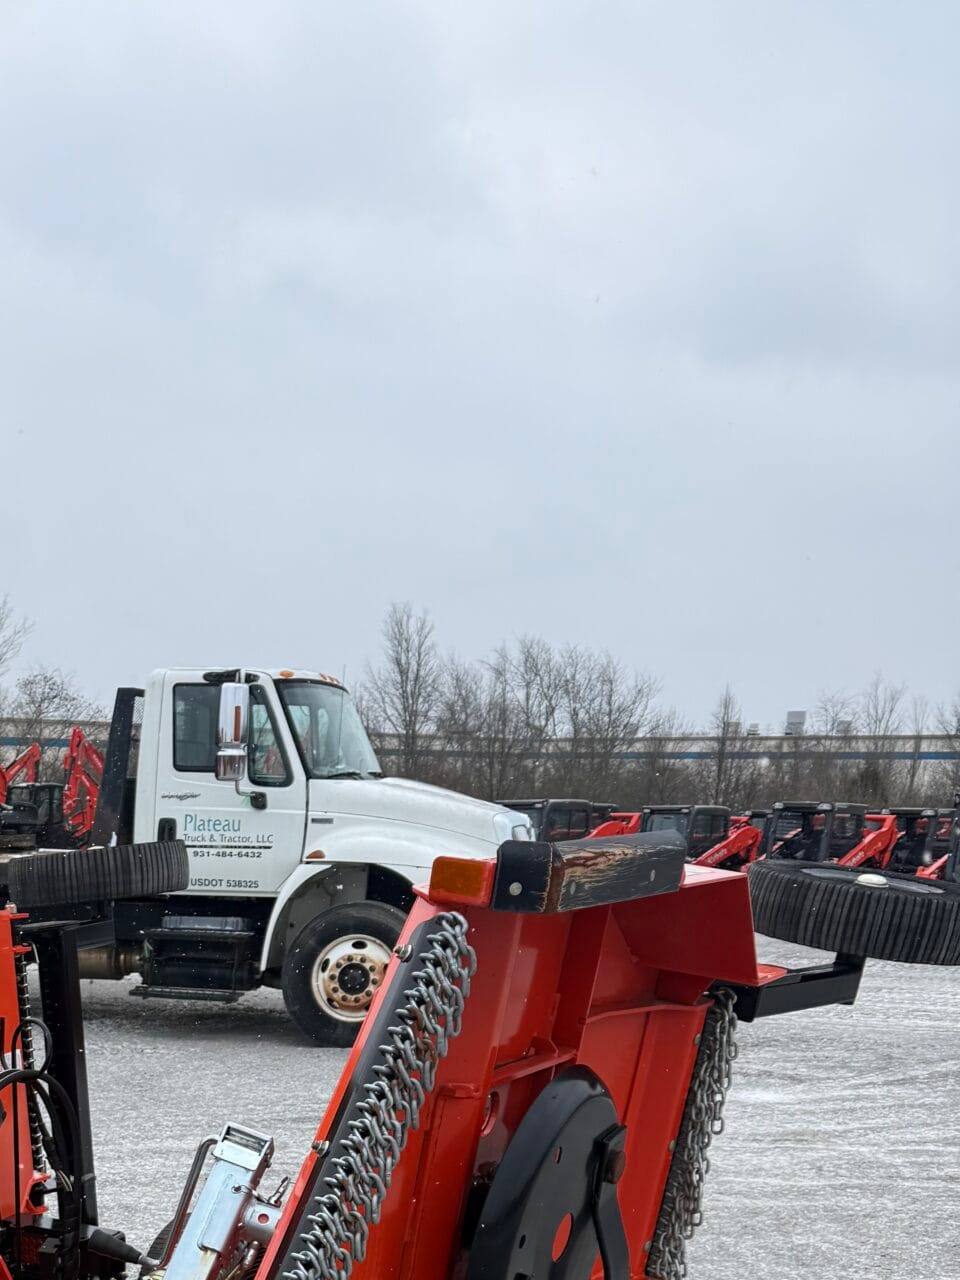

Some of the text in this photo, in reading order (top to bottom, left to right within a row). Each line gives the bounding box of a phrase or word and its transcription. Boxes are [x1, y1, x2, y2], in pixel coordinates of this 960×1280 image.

[183, 813, 242, 832] Plateau
[183, 833, 274, 844] Truck & Tractor, LLC
[192, 850, 262, 859] 931-484-6432
[190, 878, 260, 889] USDOT 538325
